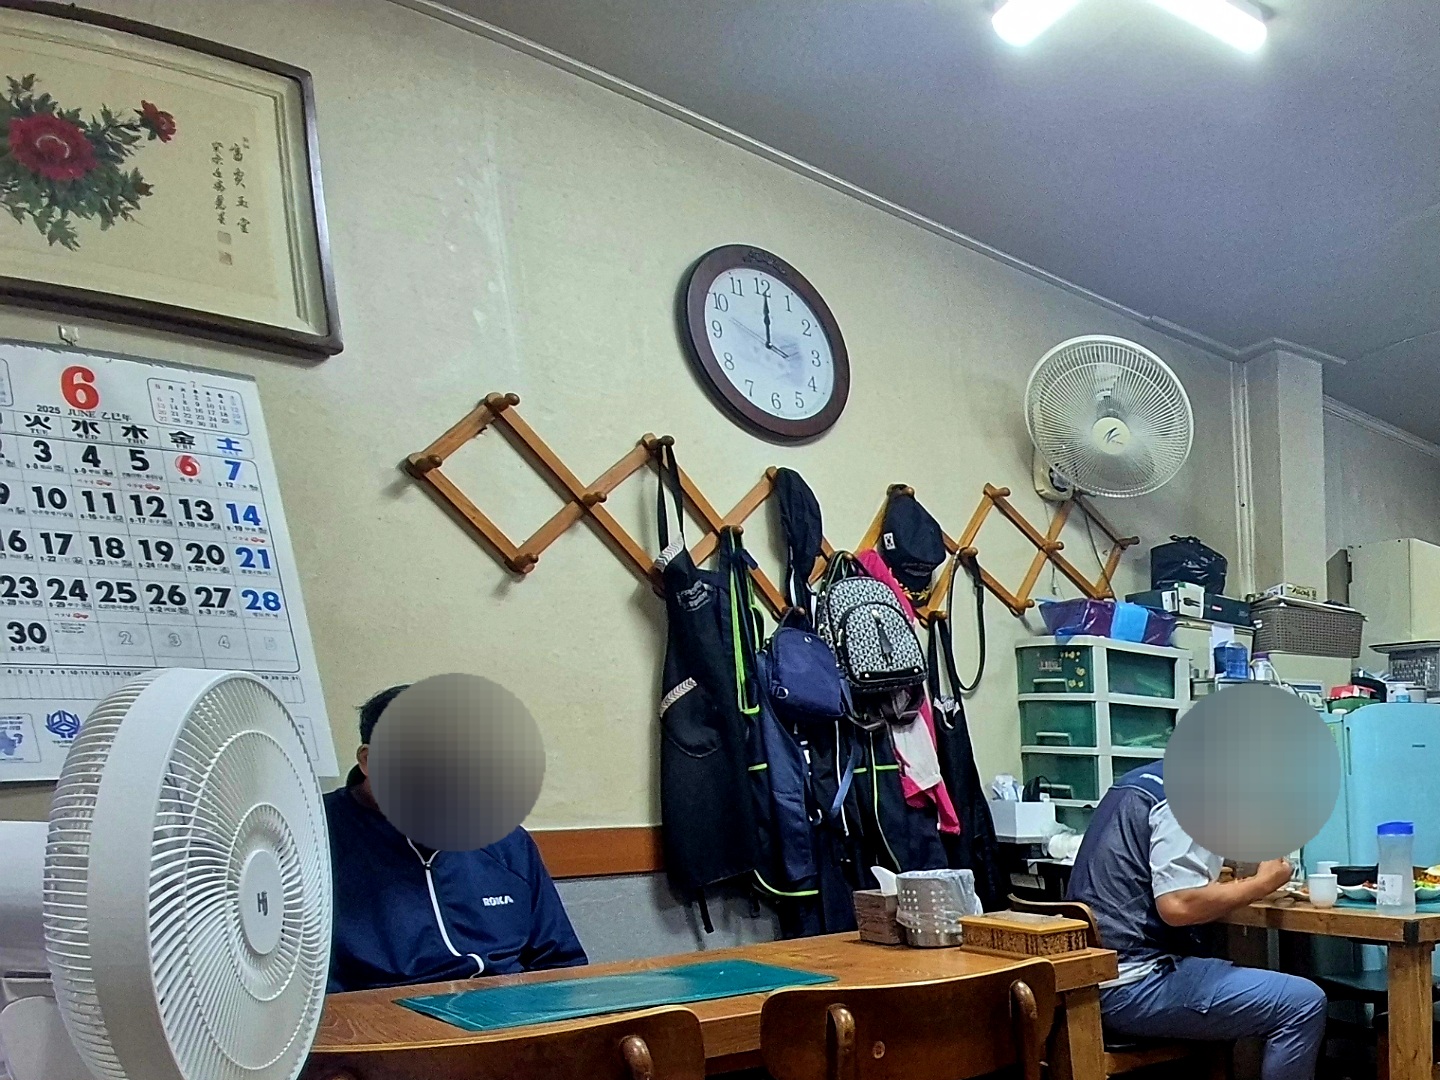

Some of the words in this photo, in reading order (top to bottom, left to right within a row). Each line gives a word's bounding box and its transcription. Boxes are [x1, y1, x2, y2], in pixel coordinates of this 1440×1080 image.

[729, 277, 745, 297] 11
[754, 277, 771, 298] 12
[713, 292, 729, 312] 10
[785, 295, 792, 313] 1
[711, 320, 723, 338] 9
[801, 318, 812, 337] 2
[724, 352, 735, 370] 8
[811, 350, 822, 368] 3
[61, 365, 100, 410] 6
[744, 379, 754, 397] 7
[807, 376, 818, 393] 4
[771, 392, 782, 410] 6
[795, 391, 805, 409] 5
[37, 404, 61, 414] 2025
[68, 408, 97, 418] JUNE
[24, 414, 52, 430] 火
[71, 419, 101, 435] 水
[121, 424, 149, 440] 木
[168, 430, 196, 446] 金
[217, 437, 243, 452] 土
[33, 439, 53, 463] 3
[81, 445, 101, 468] 4
[128, 448, 150, 472] 5
[179, 455, 198, 477] 6
[224, 460, 242, 481] 7
[31, 486, 67, 510] 10
[81, 490, 117, 514] 11
[129, 494, 167, 518] 12
[178, 498, 214, 522] 13
[226, 503, 261, 526] 14
[39, 532, 74, 556] 17
[88, 536, 126, 559] 18
[138, 539, 174, 562] 19
[185, 542, 225, 566] 20
[235, 546, 271, 570] 21
[0, 575, 39, 599] 23
[46, 578, 88, 602] 24
[95, 580, 138, 604] 25
[145, 583, 187, 606] 26
[194, 586, 232, 609] 27
[241, 589, 282, 611] 28
[6, 621, 48, 645] 30
[118, 630, 134, 645] 2
[168, 632, 182, 647] 3
[218, 634, 231, 649] 4
[481, 894, 514, 907] ROKA
